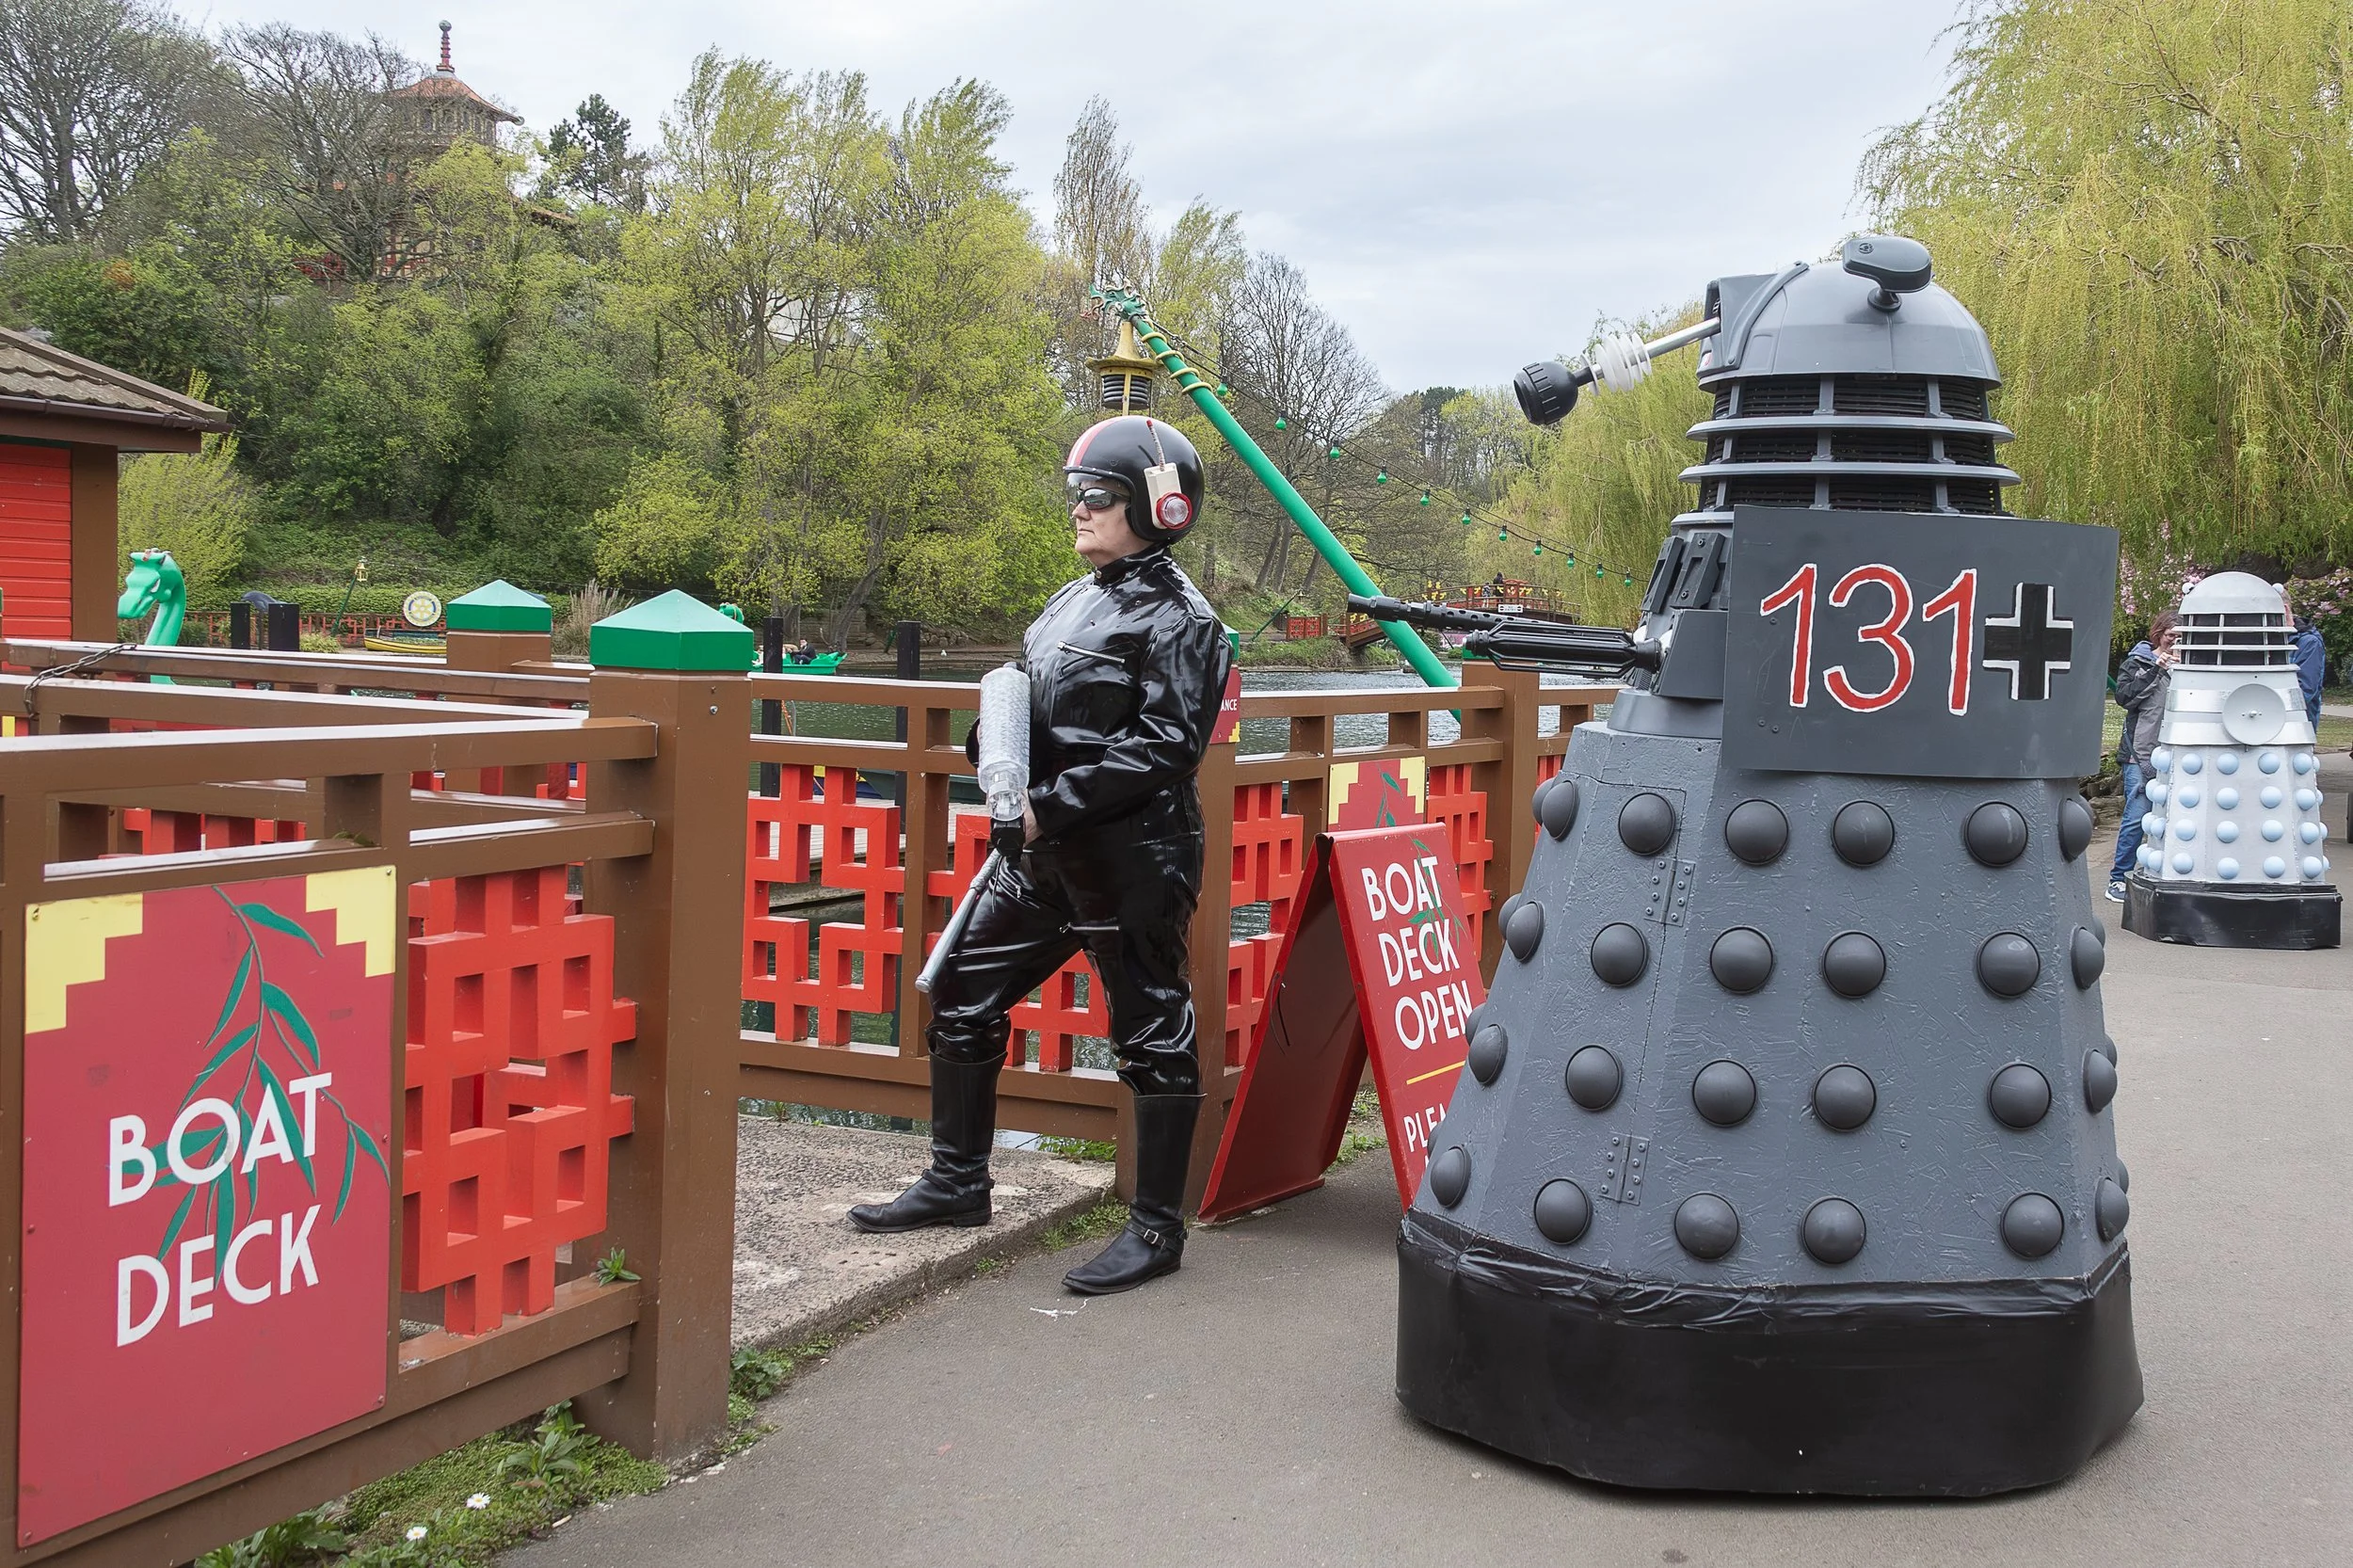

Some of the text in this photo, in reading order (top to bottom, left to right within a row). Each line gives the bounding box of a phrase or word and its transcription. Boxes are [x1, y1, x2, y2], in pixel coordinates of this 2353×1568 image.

[1760, 563, 1977, 716] 131
[1361, 856, 1443, 921] BOAT
[1378, 919, 1460, 987] DECK
[1395, 980, 1473, 1050] OPEN
[108, 1072, 332, 1207] BOAT
[117, 1204, 322, 1347] DECK
